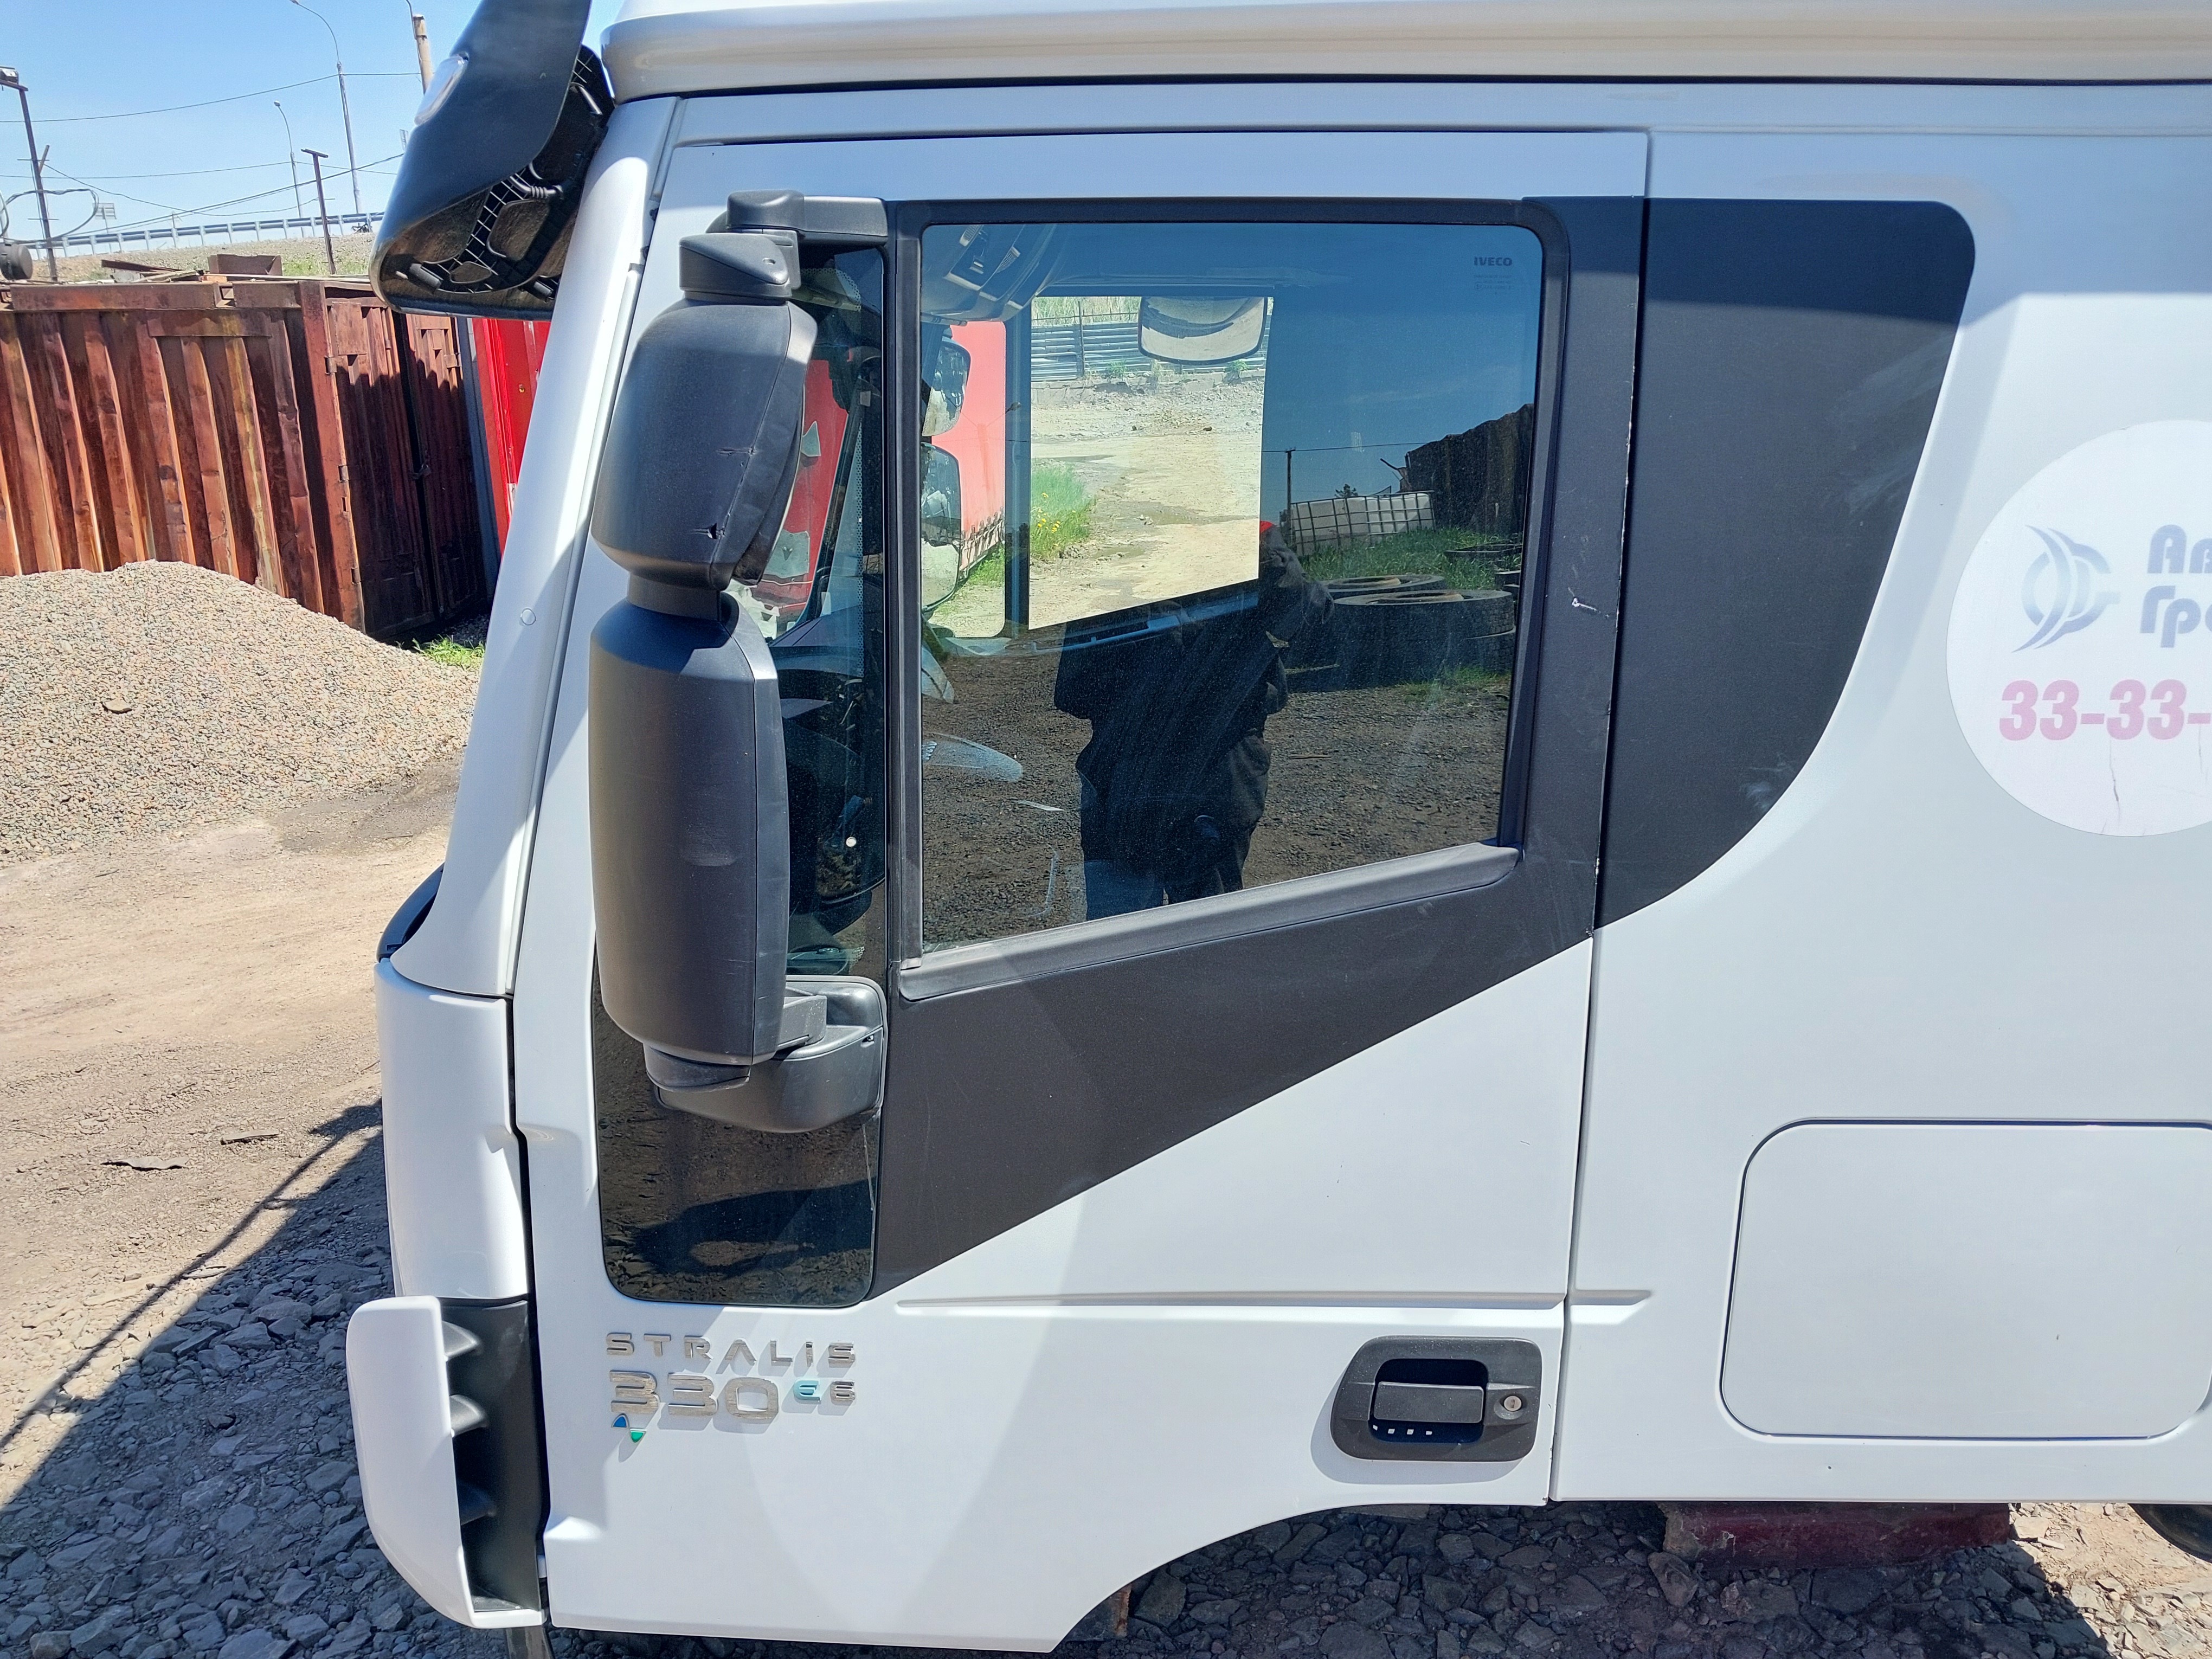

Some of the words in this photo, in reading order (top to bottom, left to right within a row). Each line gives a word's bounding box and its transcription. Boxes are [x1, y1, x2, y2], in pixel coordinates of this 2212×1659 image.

[1474, 257, 1513, 266] IVECO
[2140, 586, 2212, 648] Гр
[606, 1333, 856, 1368] STRALIS
[610, 1369, 779, 1419] 330
